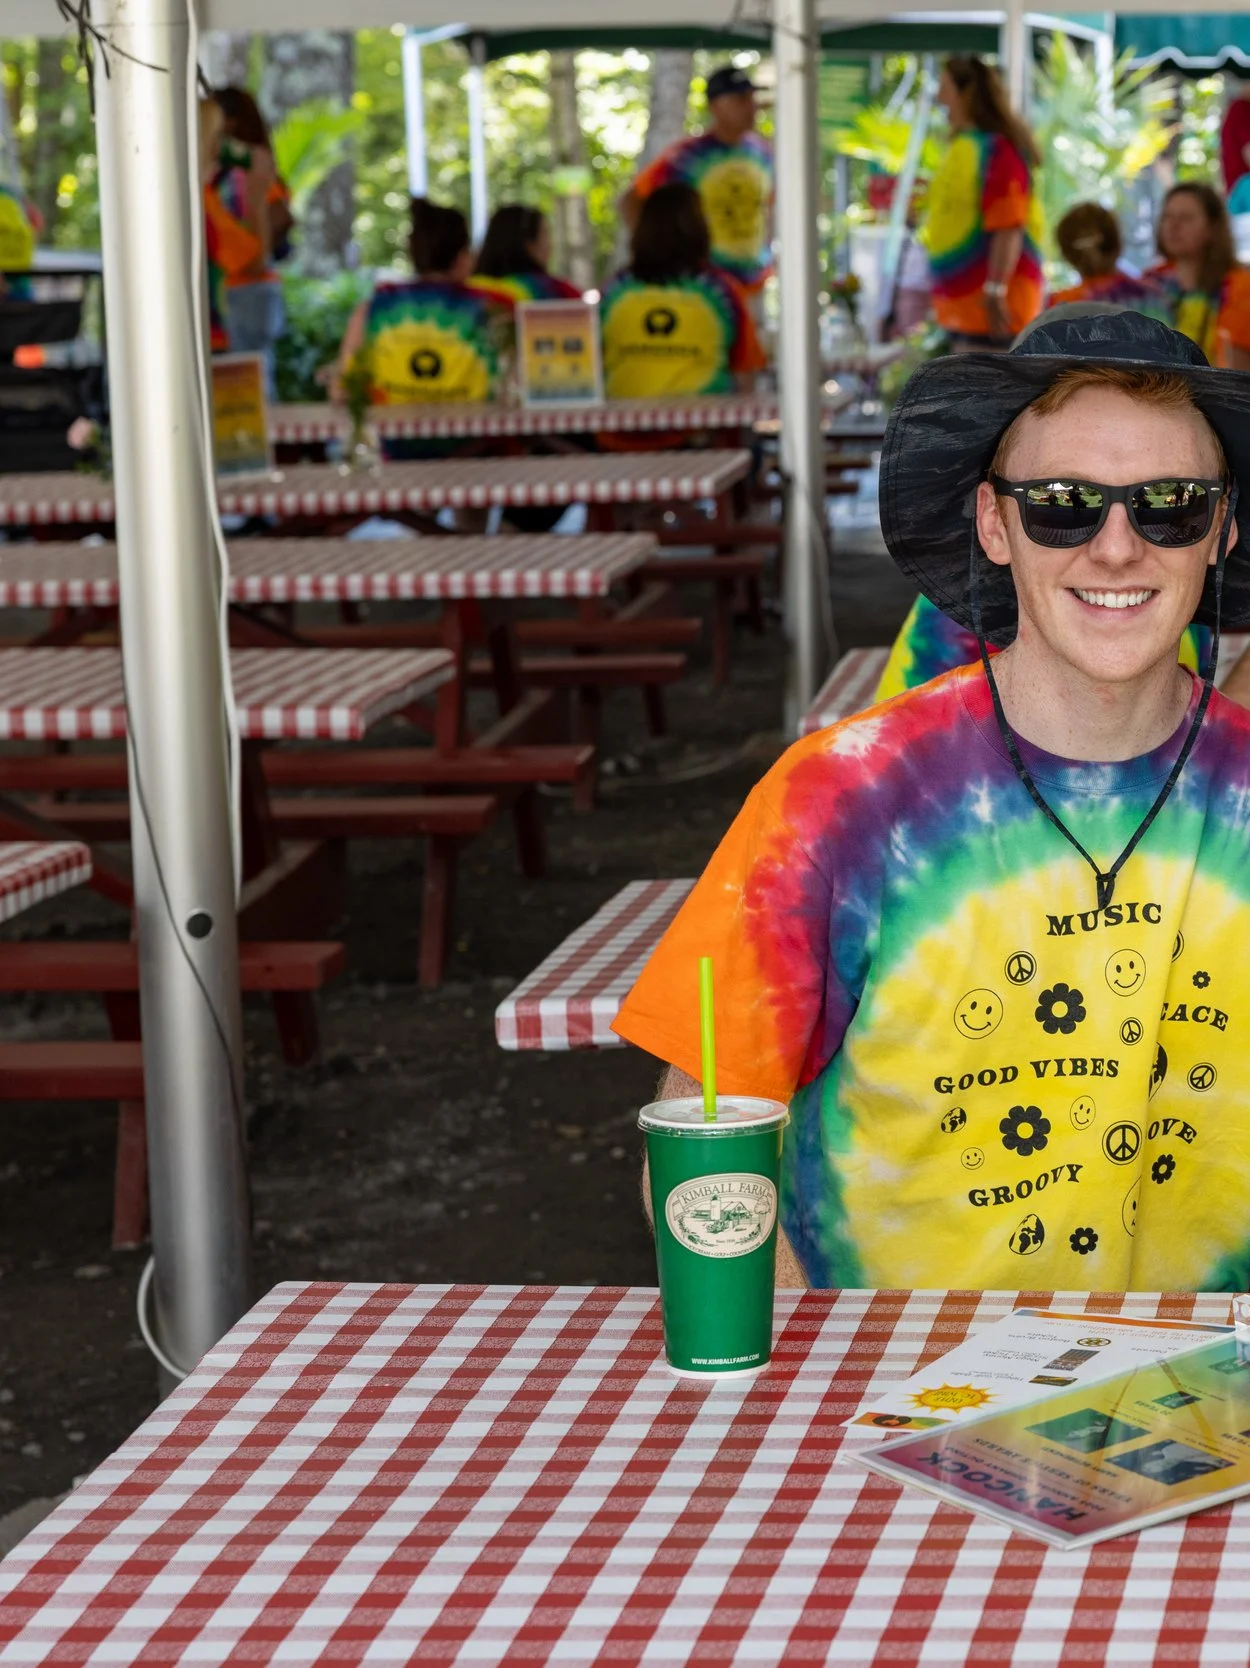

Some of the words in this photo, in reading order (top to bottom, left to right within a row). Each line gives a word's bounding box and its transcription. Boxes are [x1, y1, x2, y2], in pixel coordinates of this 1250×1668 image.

[1046, 902, 1162, 936] MUSIC
[934, 1066, 1019, 1094] GOOD
[1029, 1057, 1120, 1079] VIBES
[1147, 1117, 1197, 1145] OVE
[681, 1183, 735, 1204] KIMBALL
[738, 1182, 768, 1197] FARM
[968, 1163, 1083, 1208] GROOVY
[691, 1353, 760, 1366] WWW.KIMBALLFARM.COM
[1132, 1399, 1159, 1413] YEARS
[1220, 1432, 1248, 1446] YEARS
[915, 1451, 1089, 1521] HANCOCK
